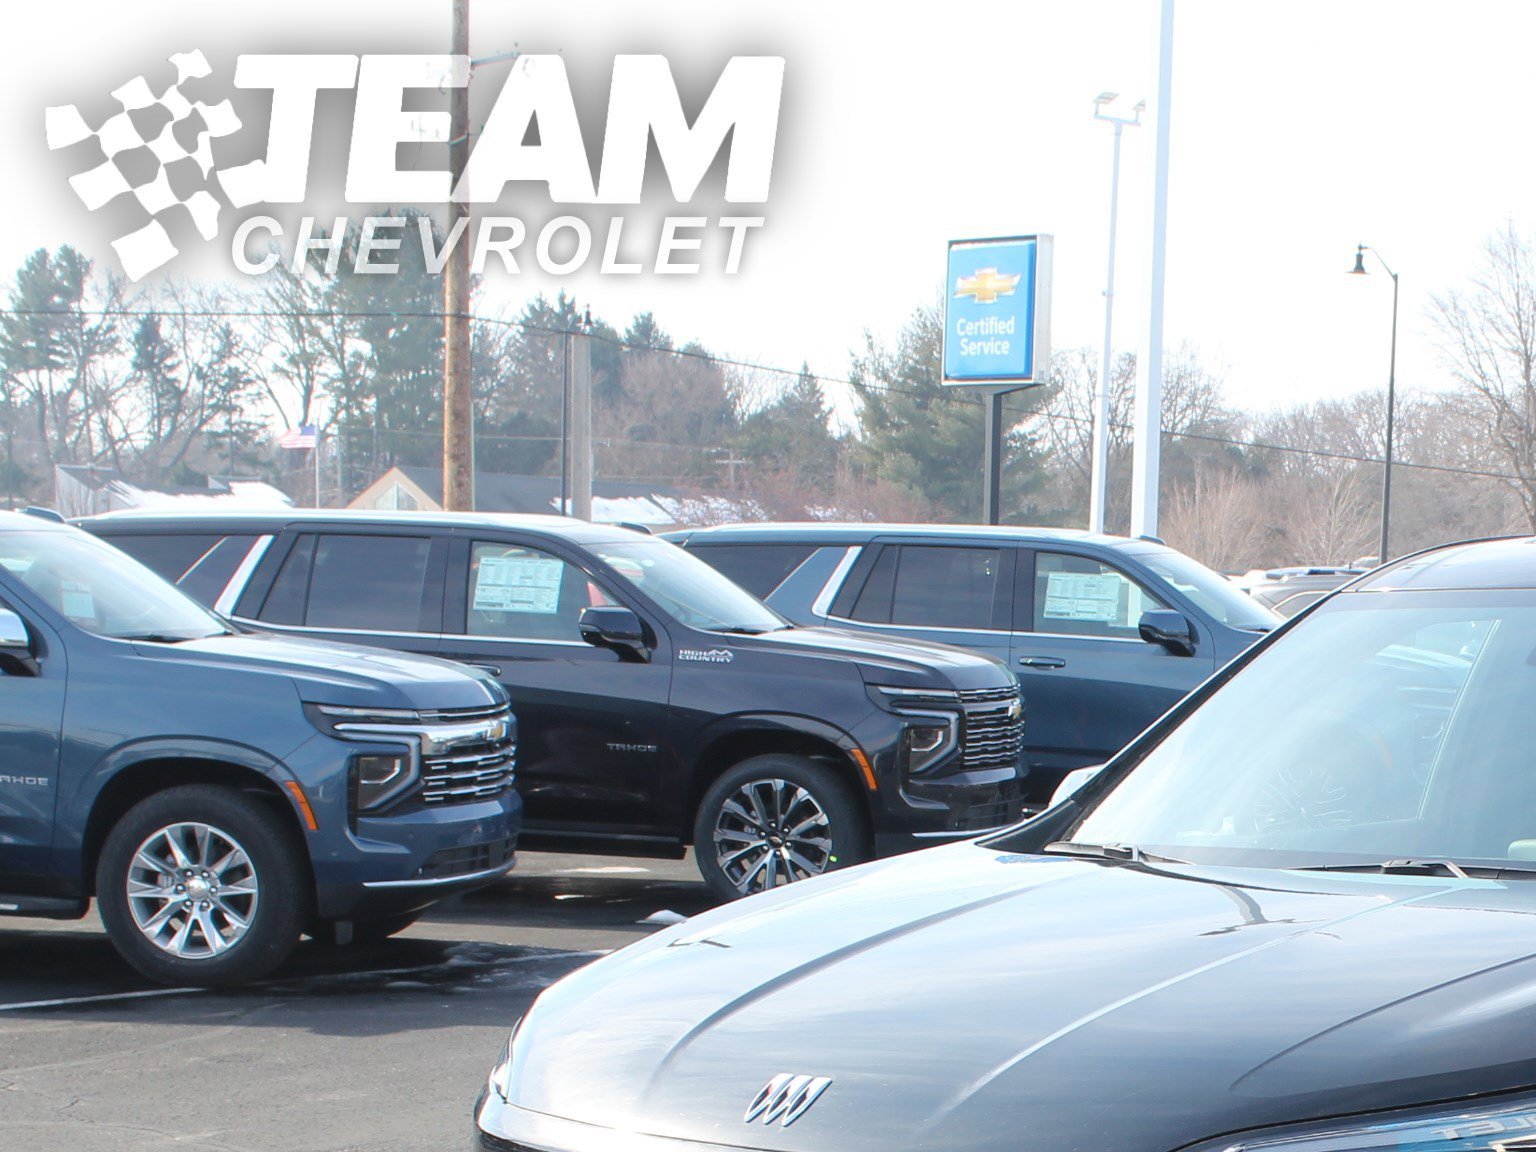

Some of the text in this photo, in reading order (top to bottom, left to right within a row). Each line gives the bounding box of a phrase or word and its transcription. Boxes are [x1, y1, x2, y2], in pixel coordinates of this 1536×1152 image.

[957, 316, 1015, 336] Certified
[960, 338, 1009, 356] Service
[678, 655, 733, 663] COUNTRY
[606, 742, 658, 752] TAHOE
[0, 774, 49, 786] AHOE
